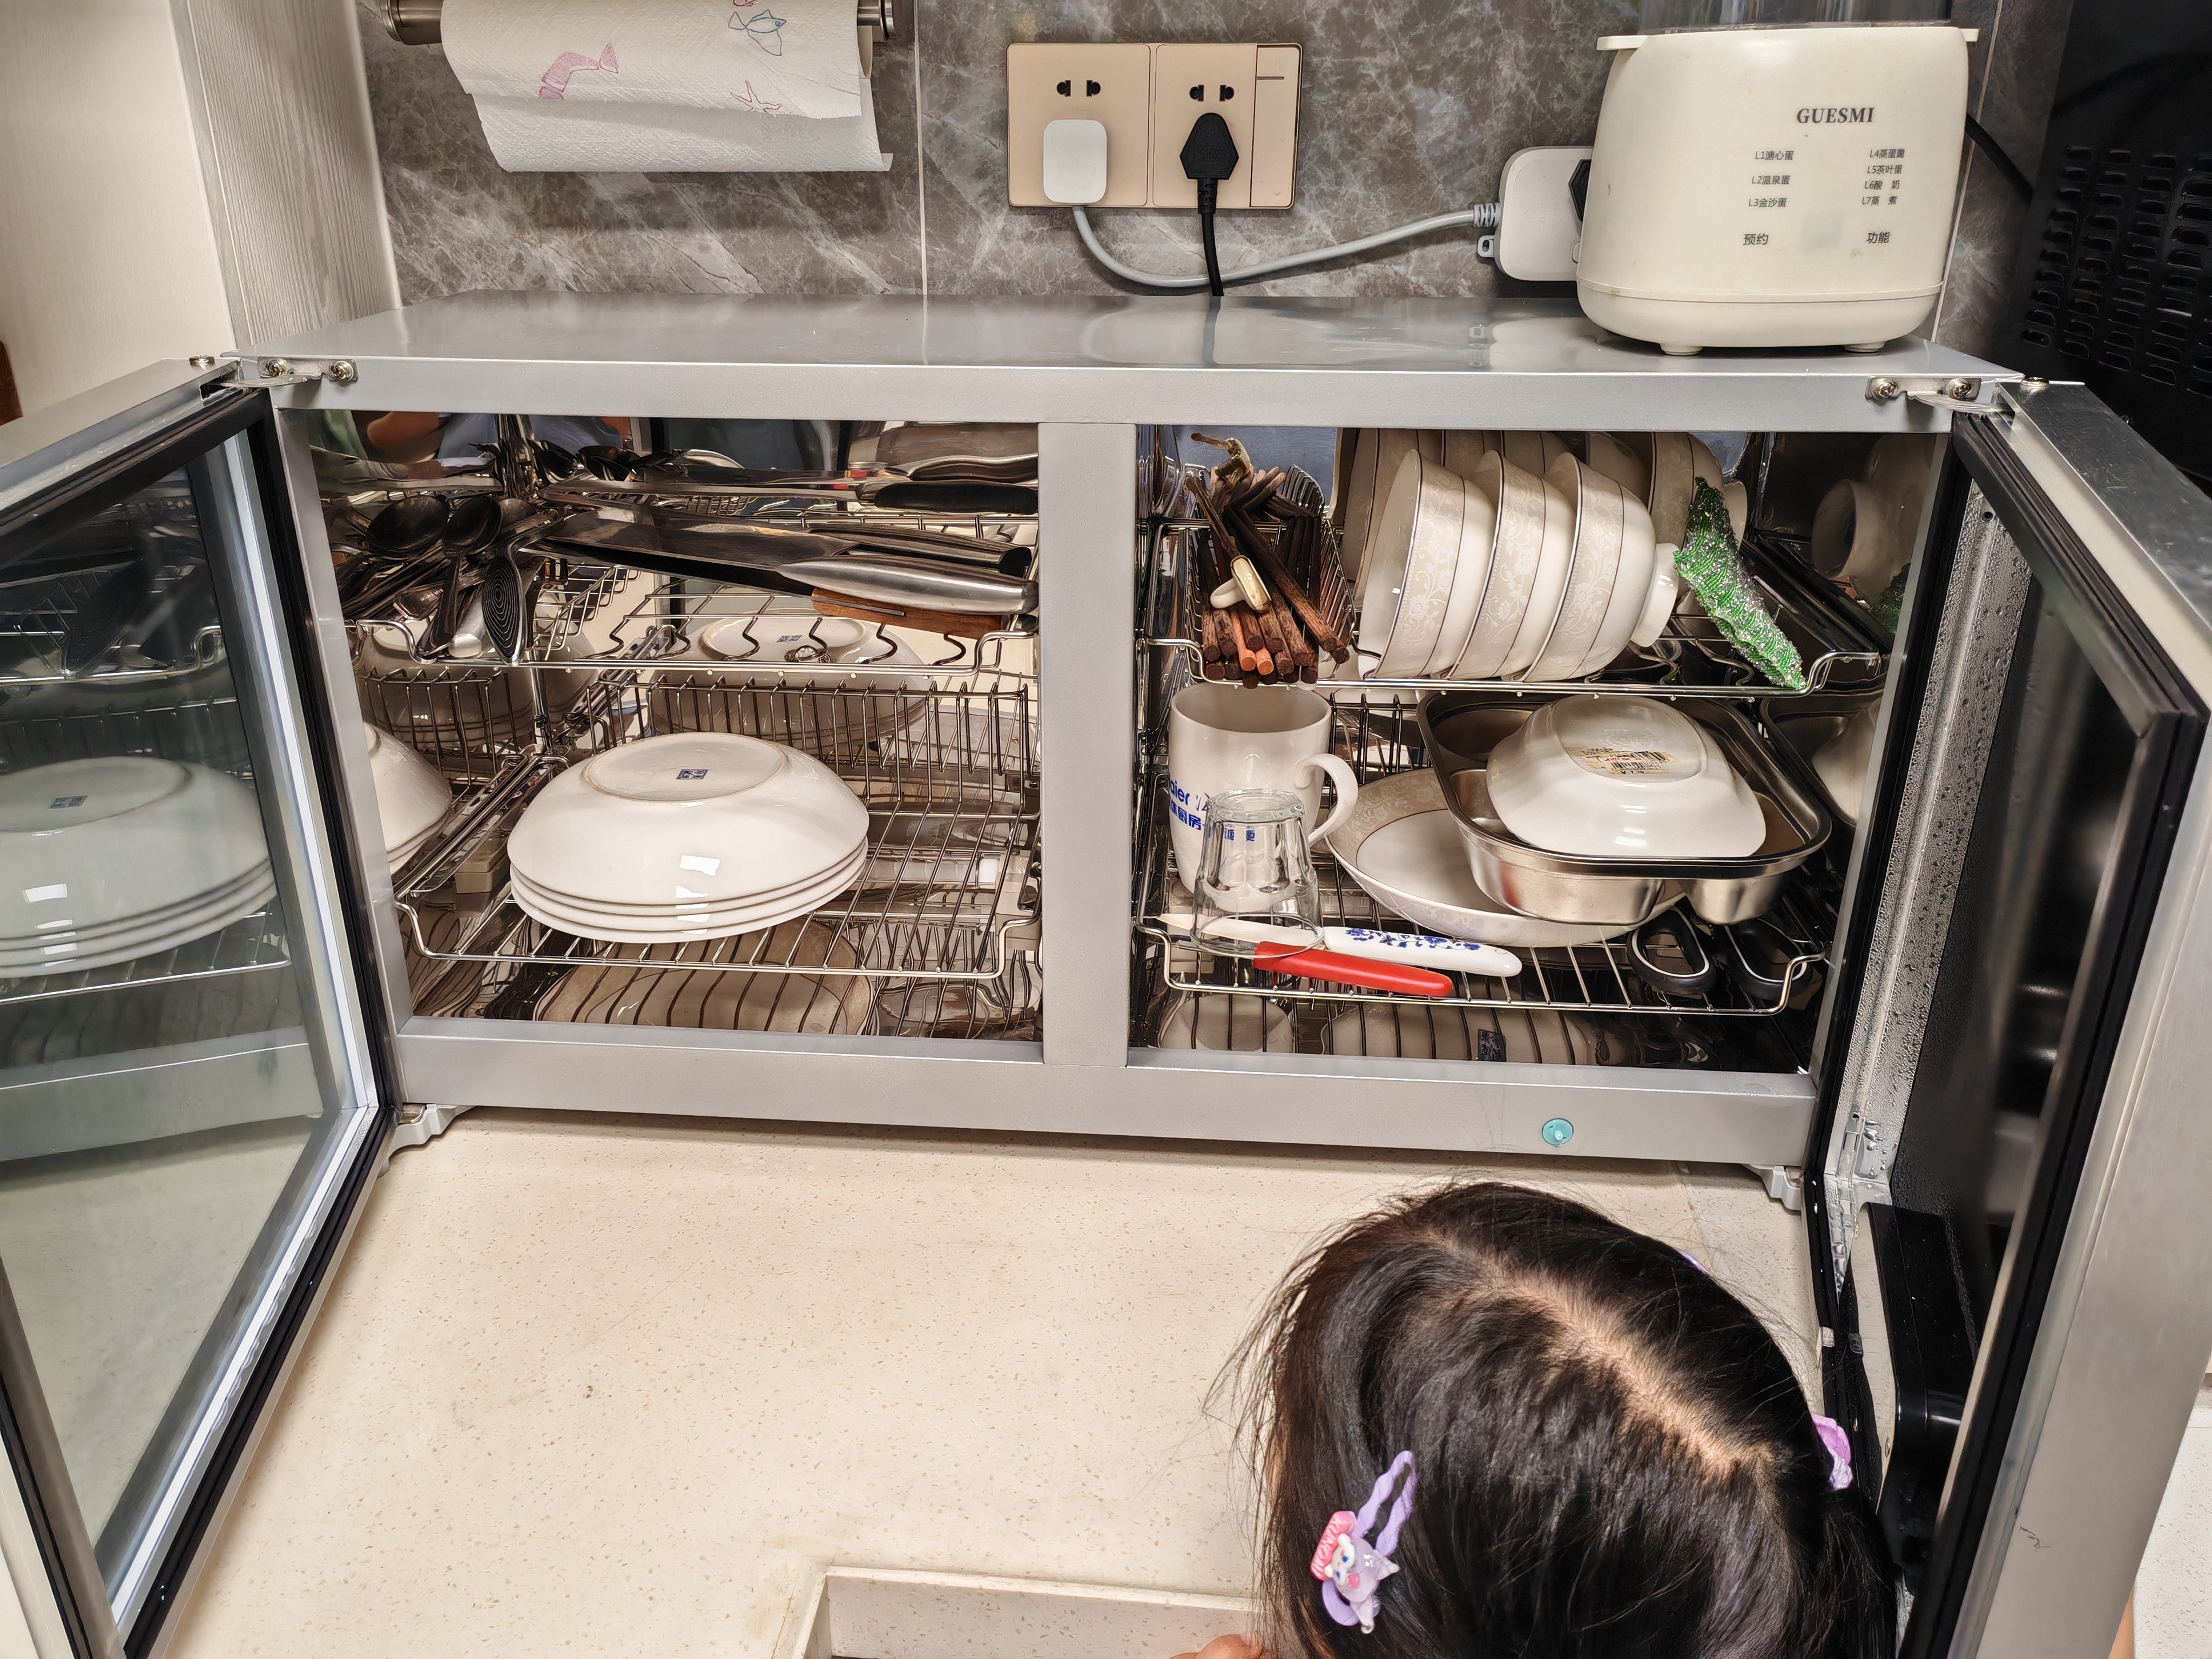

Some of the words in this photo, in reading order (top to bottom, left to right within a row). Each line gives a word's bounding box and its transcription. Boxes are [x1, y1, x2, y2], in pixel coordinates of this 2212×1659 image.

[1796, 107, 1876, 124] GUESMI
[1755, 150, 1795, 161] L1溏心蛋
[1866, 164, 1904, 175] L5茶叶蛋
[1751, 174, 1791, 185] L2温泉蛋
[1864, 180, 1883, 190] L6酸
[1748, 197, 1788, 208] L3金沙蛋
[1862, 195, 1880, 206] L7蒸
[1742, 233, 1769, 246] 预约
[1865, 231, 1891, 244] 功能
[1170, 779, 1190, 806] aier
